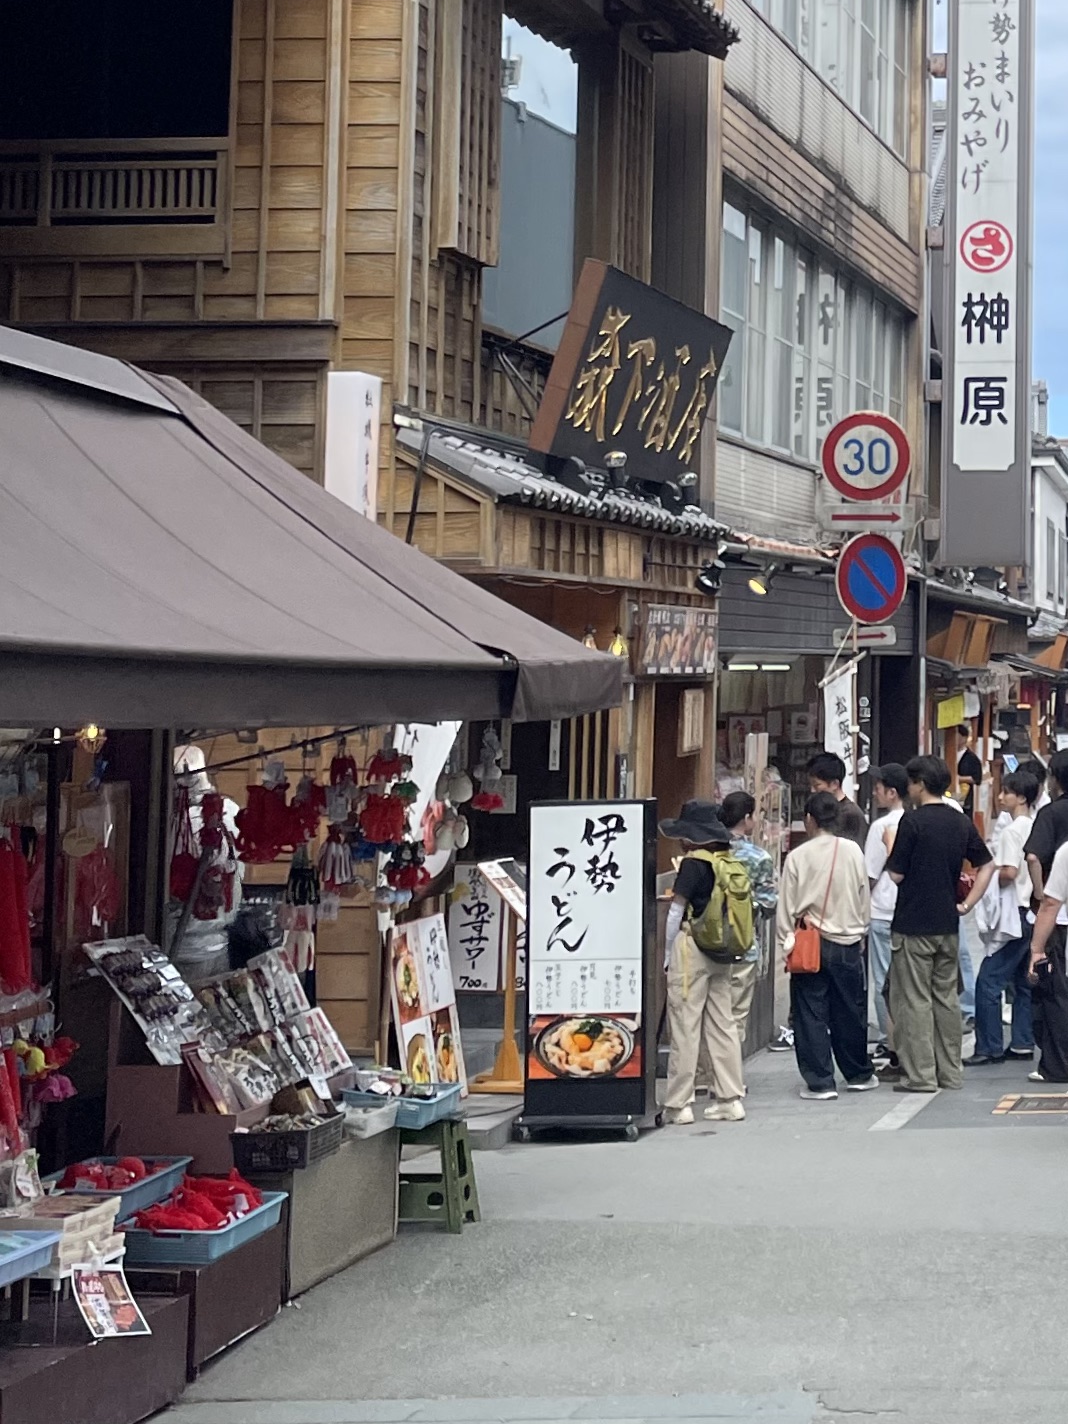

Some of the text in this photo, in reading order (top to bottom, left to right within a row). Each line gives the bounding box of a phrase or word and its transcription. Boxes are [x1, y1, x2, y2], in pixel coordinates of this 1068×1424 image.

[961, 62, 989, 194] おみやげ
[961, 292, 1009, 426] 榊原
[843, 438, 891, 476] 30
[545, 847, 589, 952] うどん
[580, 814, 627, 895] 伊勢
[459, 900, 495, 970] ゆずサワー
